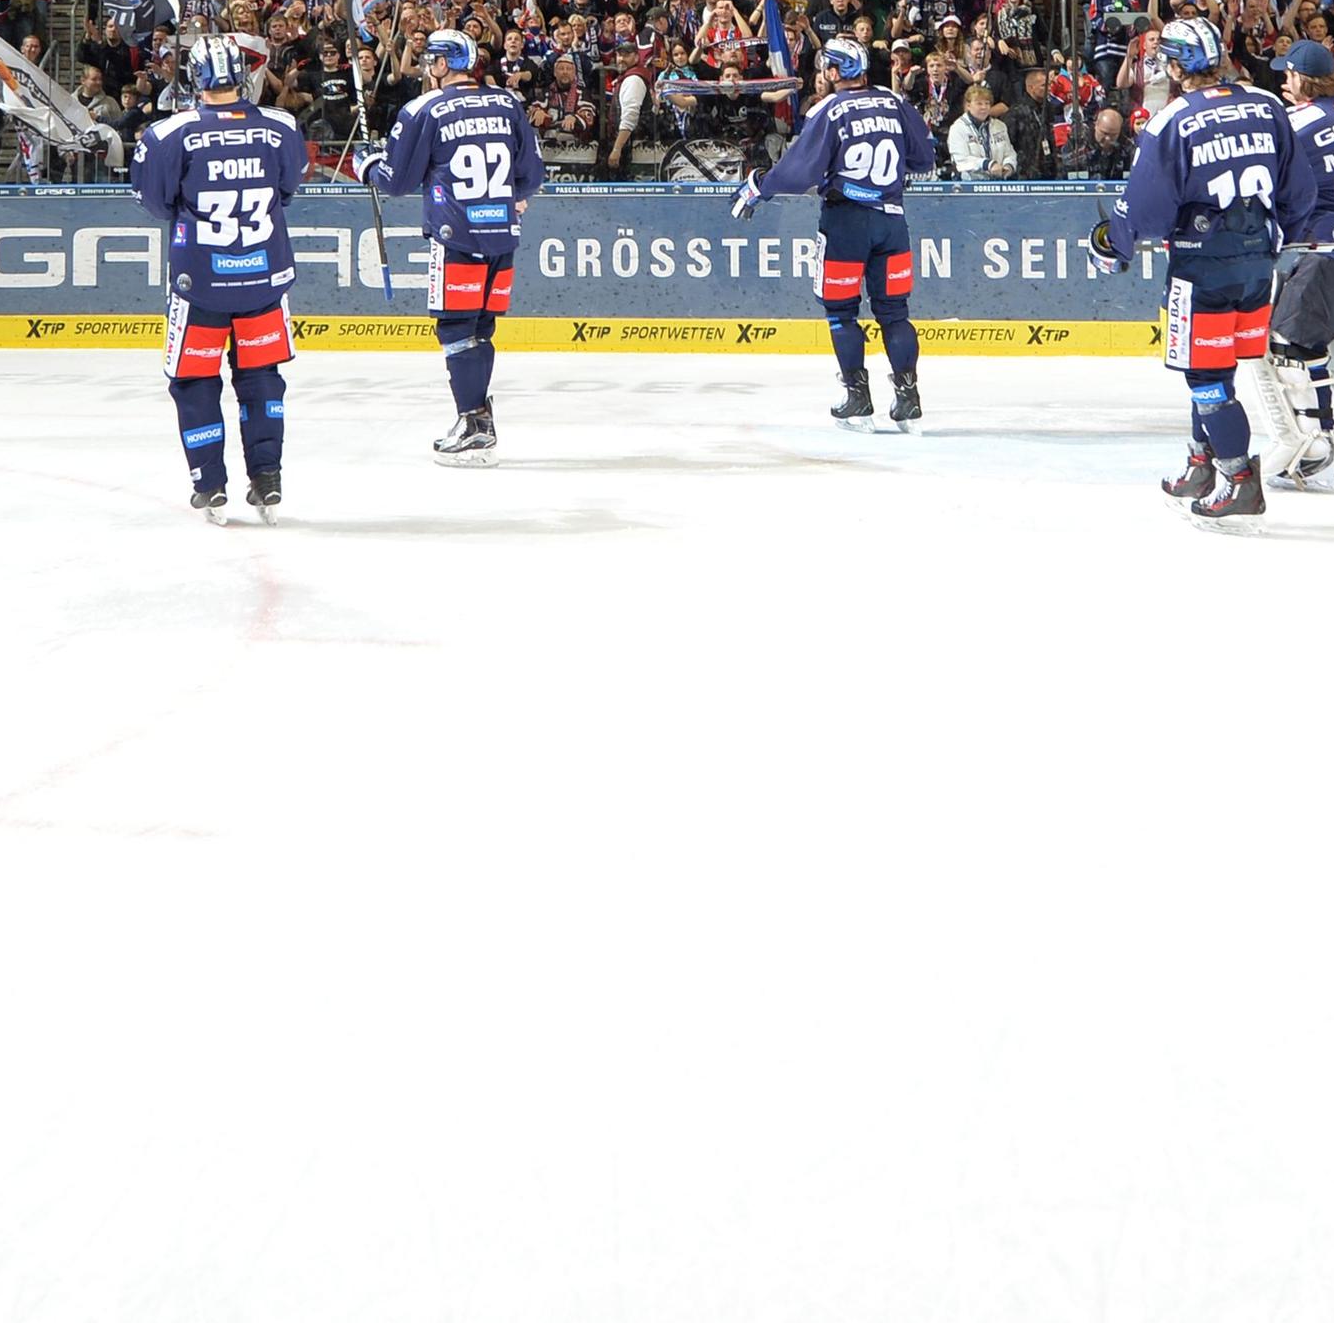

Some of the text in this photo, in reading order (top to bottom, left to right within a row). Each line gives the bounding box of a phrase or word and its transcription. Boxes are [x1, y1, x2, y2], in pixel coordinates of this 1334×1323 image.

[429, 94, 515, 119] GASAG
[826, 96, 899, 122] GASAG
[1178, 103, 1275, 139] GASAG
[183, 127, 283, 153] GASAG
[1191, 130, 1276, 168] MÜLLER
[207, 157, 265, 181] POHL
[448, 141, 514, 201] 92
[837, 138, 901, 187] 90
[33, 187, 76, 196] GASAG
[554, 185, 580, 194] PASCAL
[693, 185, 712, 194] ARVID
[195, 187, 275, 248] 33
[217, 256, 264, 269] HOWOGE
[539, 228, 817, 279] GRÖSSTER
[26, 318, 164, 339] X-TiP SPORTWETTE
[289, 319, 437, 339] X-TiP SPORTWETTEN
[572, 321, 777, 344] X-TiP SPORTWETTEN X-TiP
[1168, 284, 1183, 361] DWB-BAU
[915, 324, 1070, 346] PORTWETTEN X-TiP
[186, 427, 222, 444] HOWOGE
